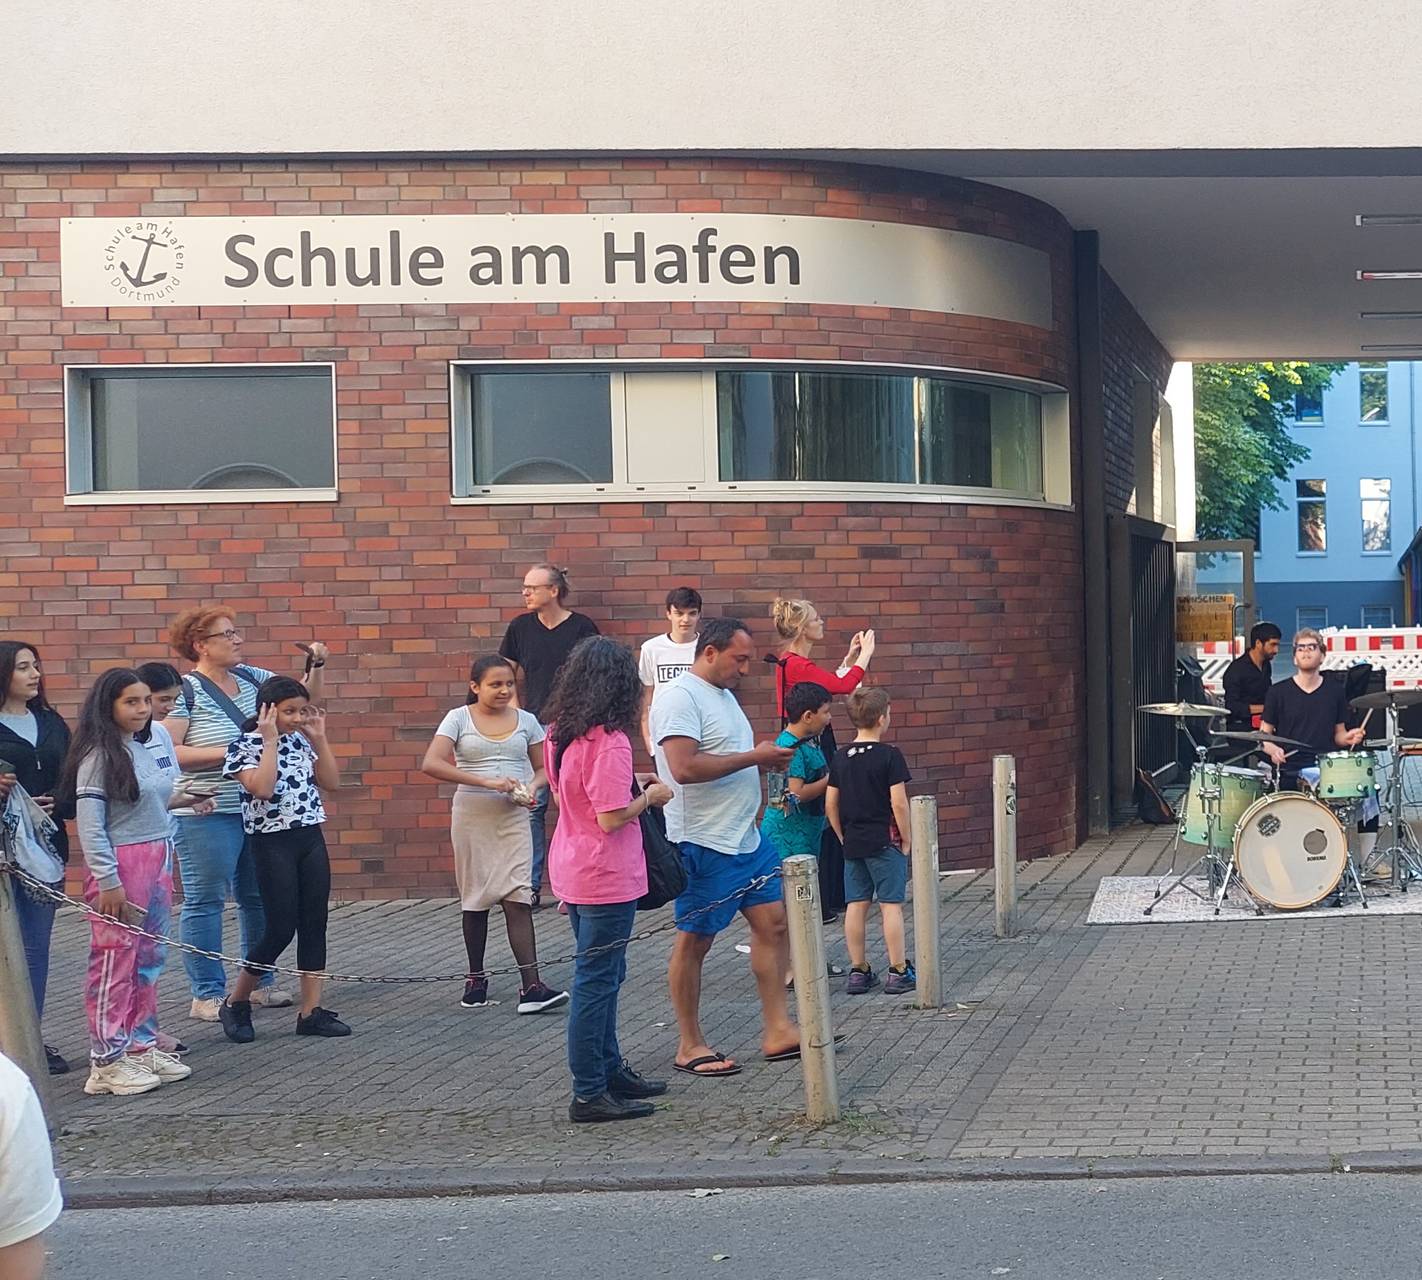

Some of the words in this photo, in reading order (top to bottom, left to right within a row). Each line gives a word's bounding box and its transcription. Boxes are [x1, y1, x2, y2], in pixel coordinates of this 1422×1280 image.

[104, 226, 133, 271] Schule
[136, 222, 158, 232] am
[161, 227, 185, 270] Hafen
[224, 230, 445, 288] Schule
[469, 245, 570, 285] am
[603, 228, 801, 285] Hafen
[110, 276, 181, 302] Dortmund
